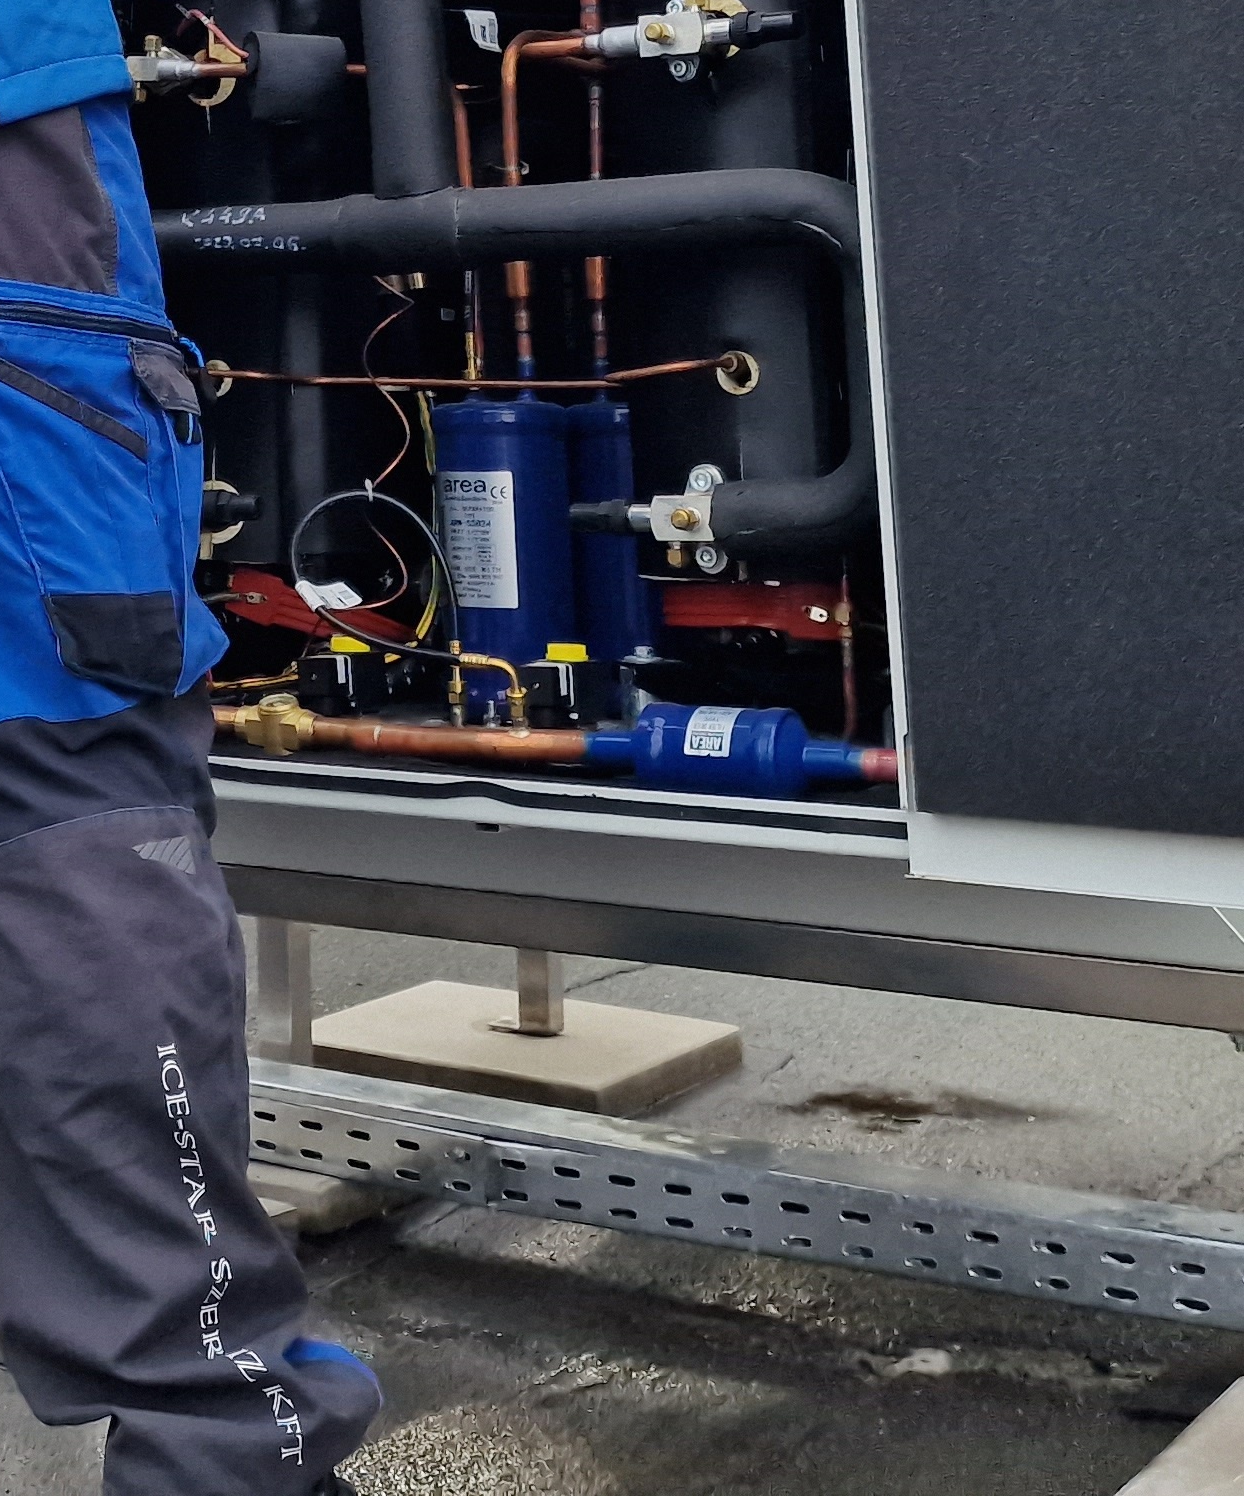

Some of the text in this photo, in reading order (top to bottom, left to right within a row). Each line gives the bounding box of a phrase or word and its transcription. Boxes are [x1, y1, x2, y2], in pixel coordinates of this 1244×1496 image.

[443, 479, 487, 493] area
[690, 735, 723, 751] AREA
[156, 1042, 304, 1467] ICE-STAR SZERIZ KFT
